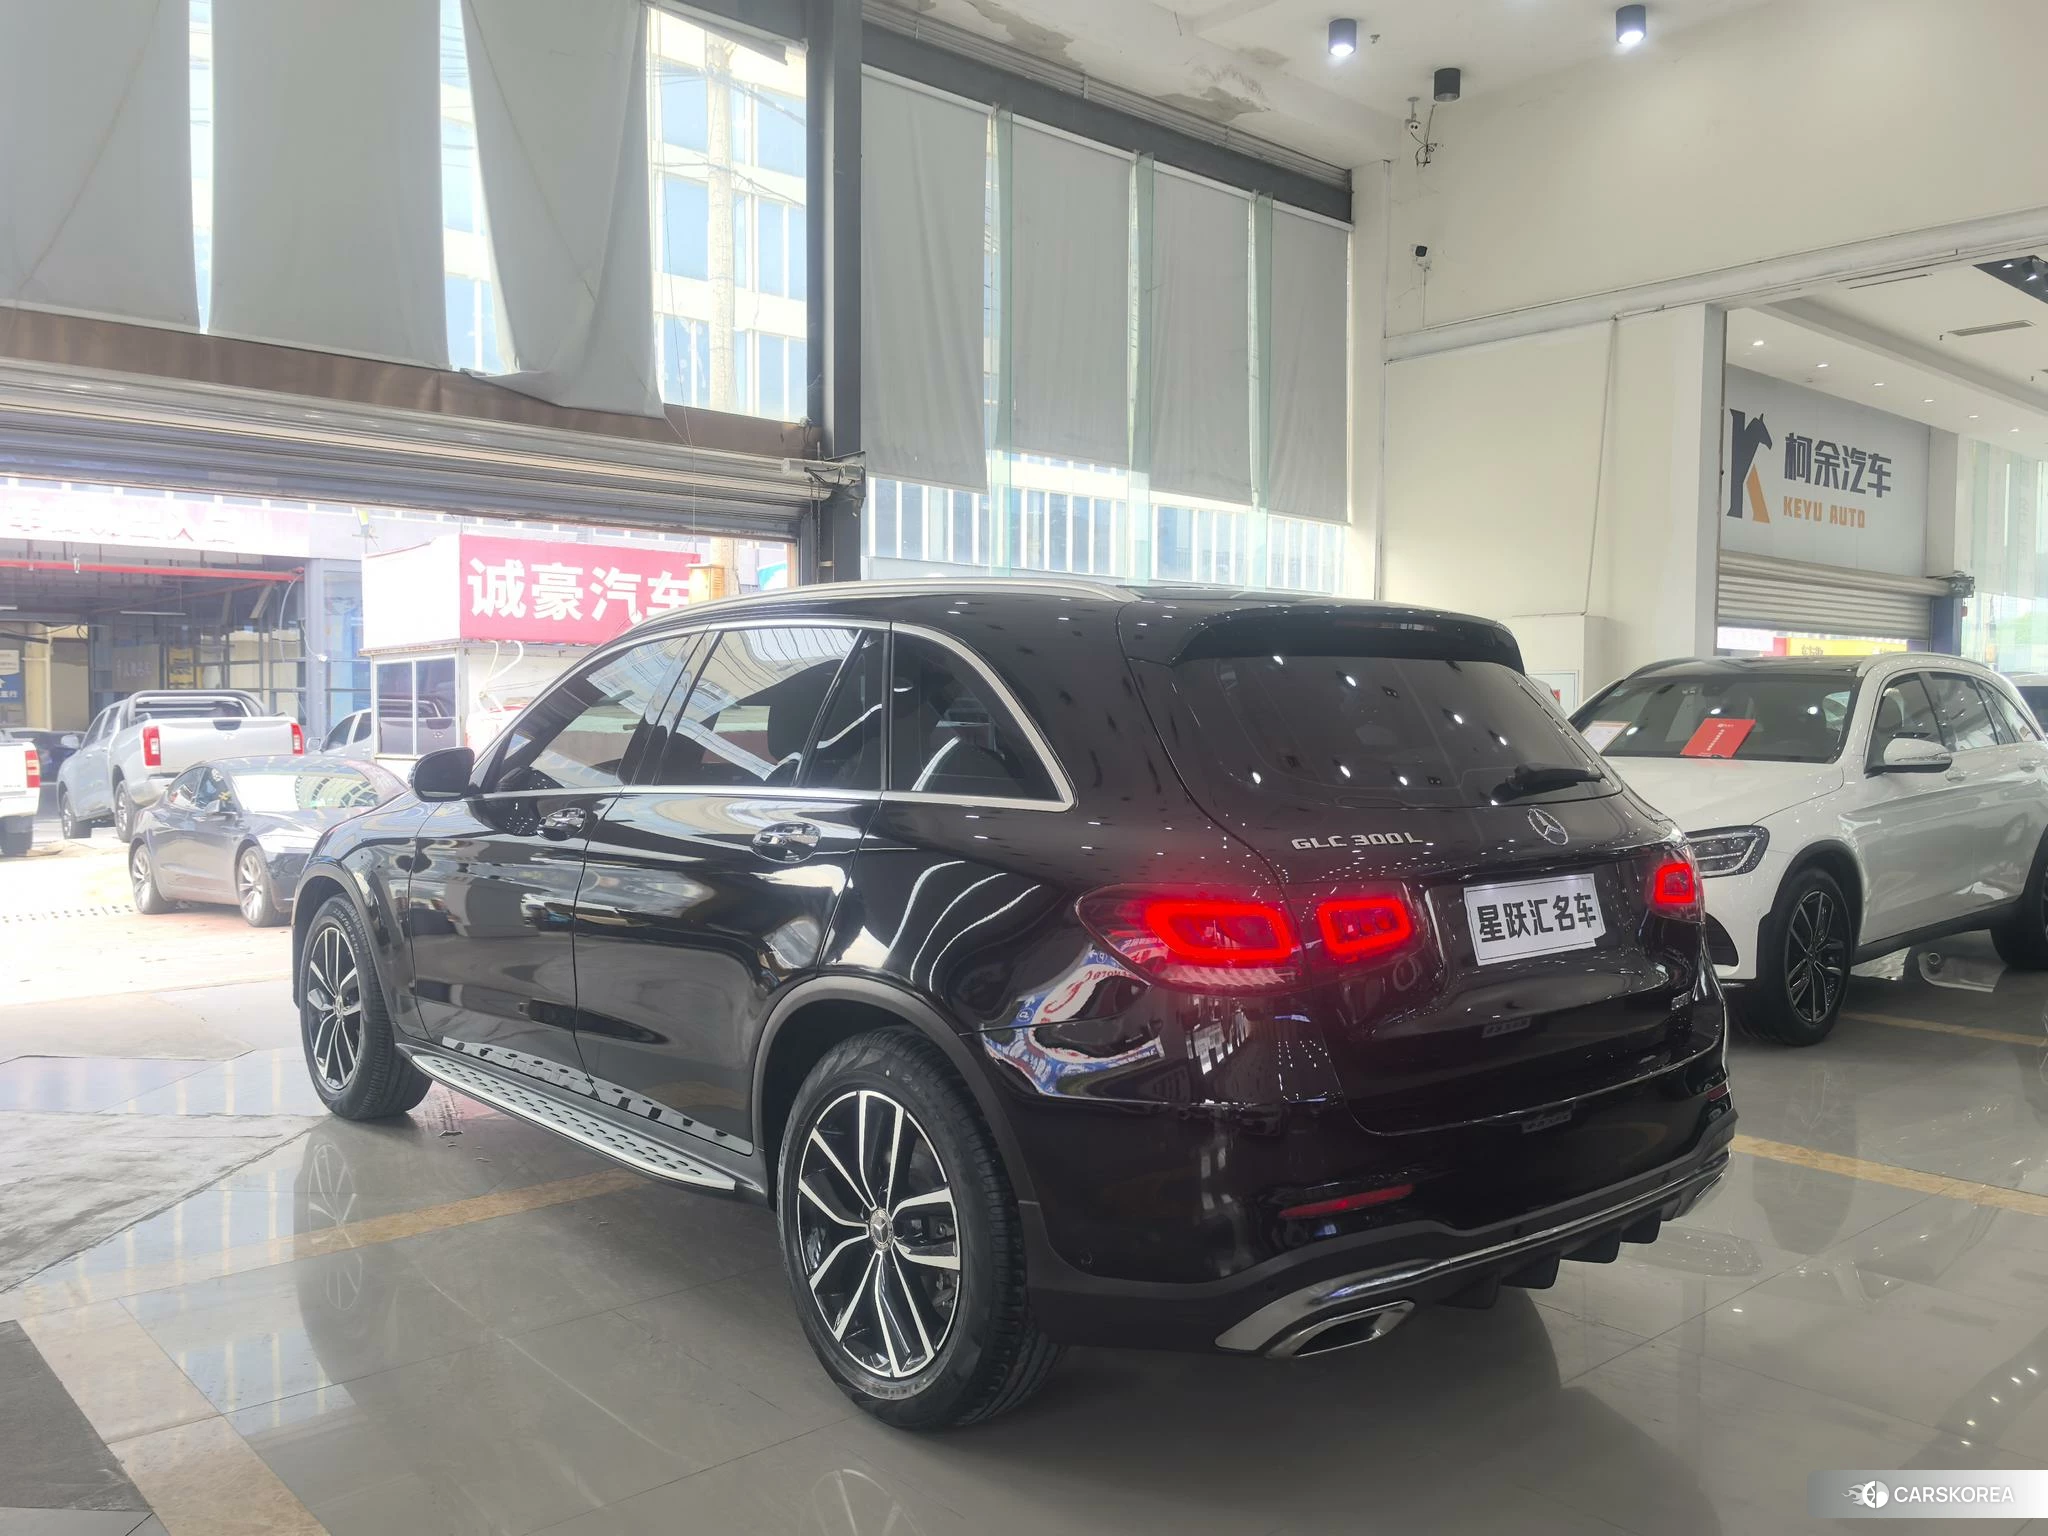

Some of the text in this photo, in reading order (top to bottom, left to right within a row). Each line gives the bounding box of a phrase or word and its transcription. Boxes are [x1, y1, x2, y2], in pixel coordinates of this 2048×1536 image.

[1784, 432, 1892, 498] 柯余汽车
[1783, 496, 1866, 529] KEYU AUTO
[467, 557, 690, 624] 诚豪汽车
[1291, 835, 1347, 850] GLC
[1350, 832, 1404, 846] 300
[1477, 892, 1597, 943] 星跃汇名车
